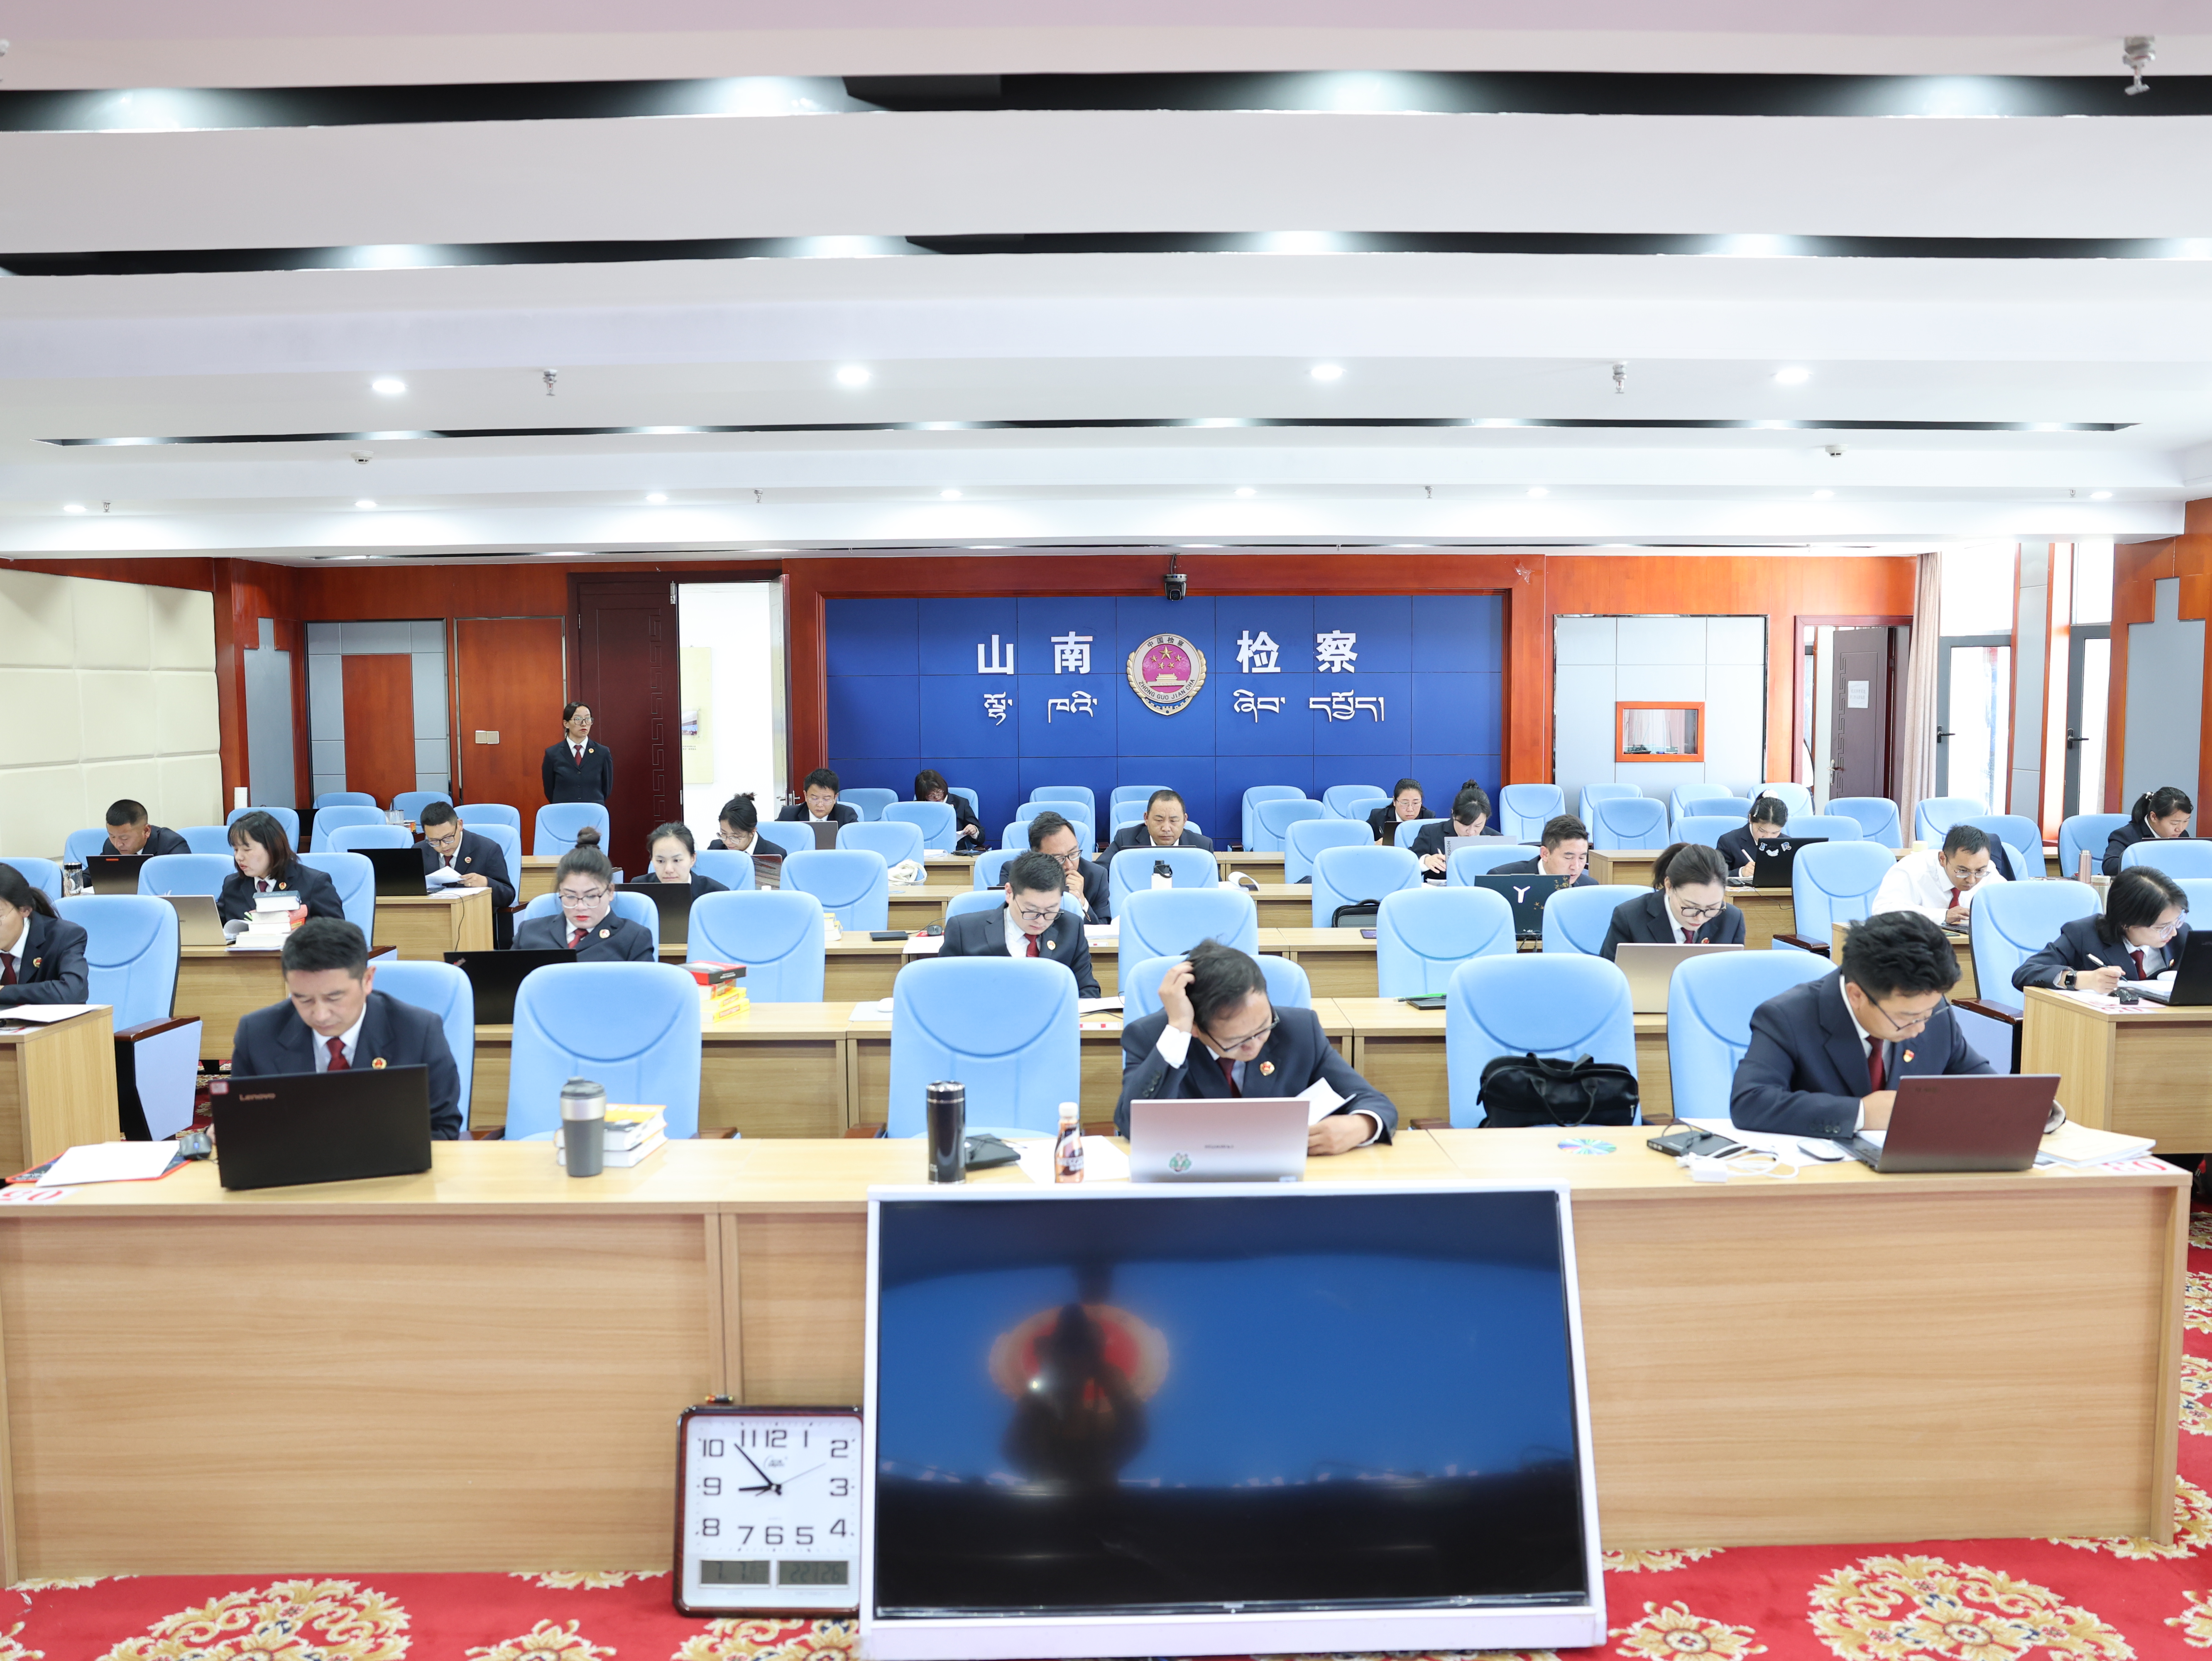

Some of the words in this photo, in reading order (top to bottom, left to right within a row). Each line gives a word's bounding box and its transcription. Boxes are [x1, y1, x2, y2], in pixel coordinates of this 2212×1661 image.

[1147, 637, 1184, 648] 中国检察
[1138, 681, 1155, 697] ZHONG
[1171, 689, 1186, 699] JIAN
[1185, 679, 1195, 690] CHA
[703, 1439, 724, 1457] 10
[741, 1429, 756, 1448] 11
[765, 1429, 788, 1448] 12
[803, 1429, 809, 1448] 1
[830, 1439, 849, 1458] 2
[703, 1477, 722, 1496] 9
[830, 1478, 849, 1496] 3
[702, 1518, 720, 1537] 8
[737, 1526, 755, 1545] 7
[765, 1526, 784, 1545] 6
[796, 1527, 814, 1545] 5
[830, 1519, 847, 1538] 4
